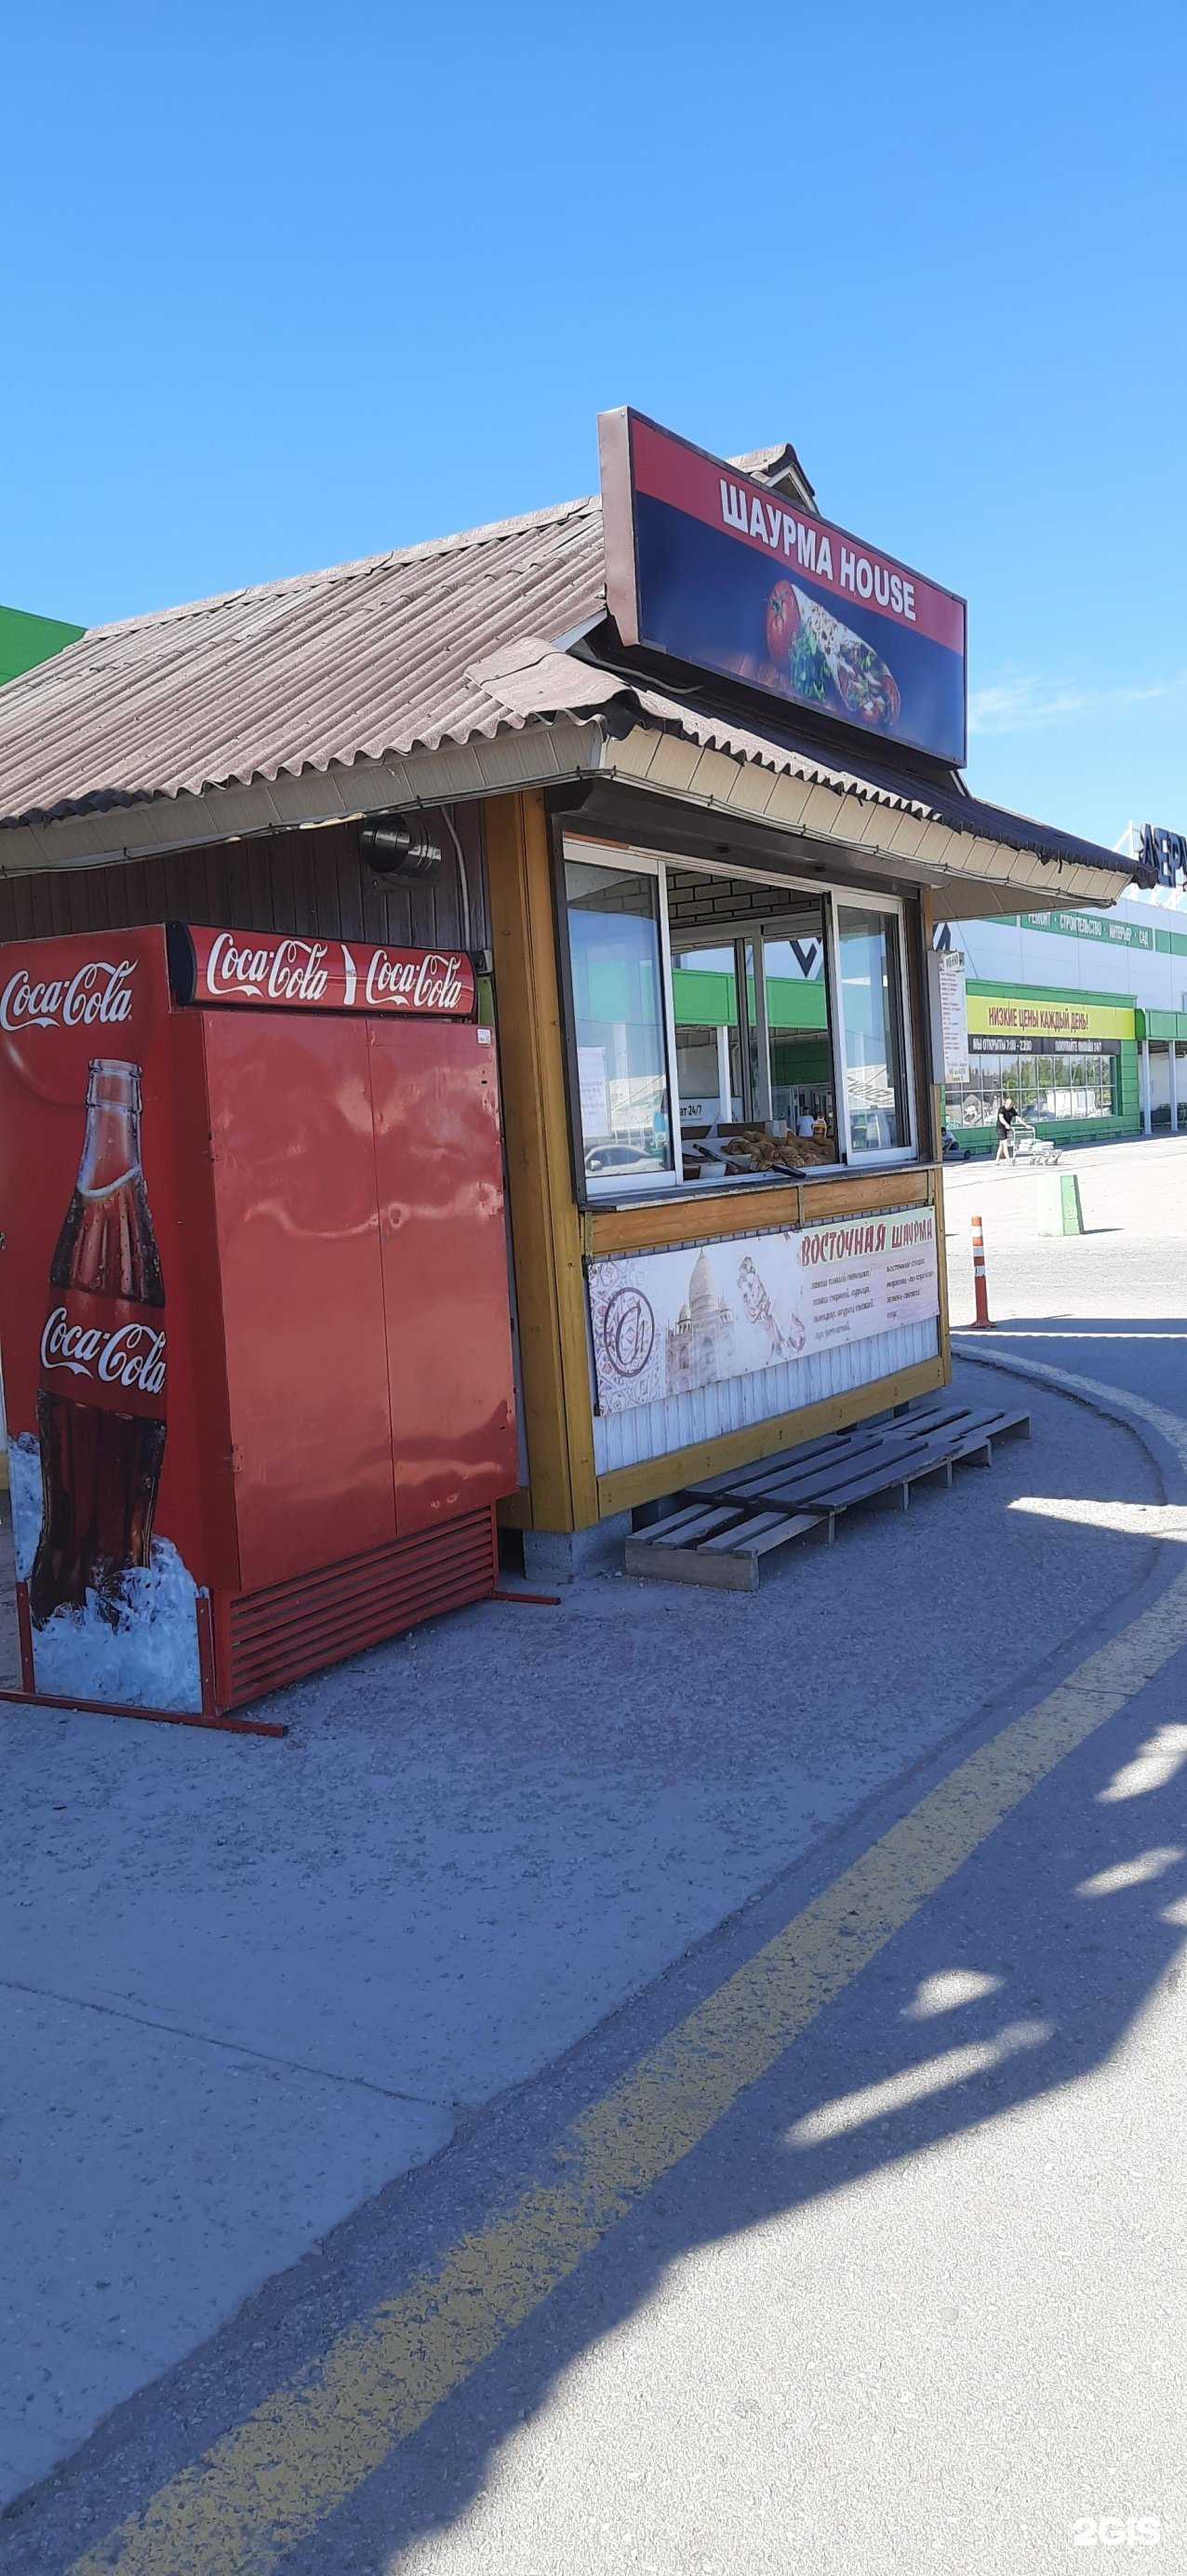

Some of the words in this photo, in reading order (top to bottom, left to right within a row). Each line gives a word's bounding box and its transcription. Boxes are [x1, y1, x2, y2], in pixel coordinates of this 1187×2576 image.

[719, 477, 833, 581] ШАУРМА
[840, 546, 916, 621] HOUSE
[1060, 914, 1102, 936] СТРОИТЕЛЬСТВО
[0, 959, 139, 1031] Coca-Cola
[207, 932, 327, 1000] Coca-Cola
[367, 949, 462, 1009] Coca-Cola
[989, 1007, 1018, 1027] НИЗКИЕ
[1019, 1009, 1039, 1031] ЦЕНЫ
[1040, 1008, 1070, 1032] КАЖДЫЙ
[1071, 1013, 1088, 1033] ДЕНЬ!
[802, 1224, 887, 1267] ВОСТОЧНАЯ
[891, 1218, 933, 1248] ШАУРМА
[41, 1307, 167, 1393] Coca-Cola
